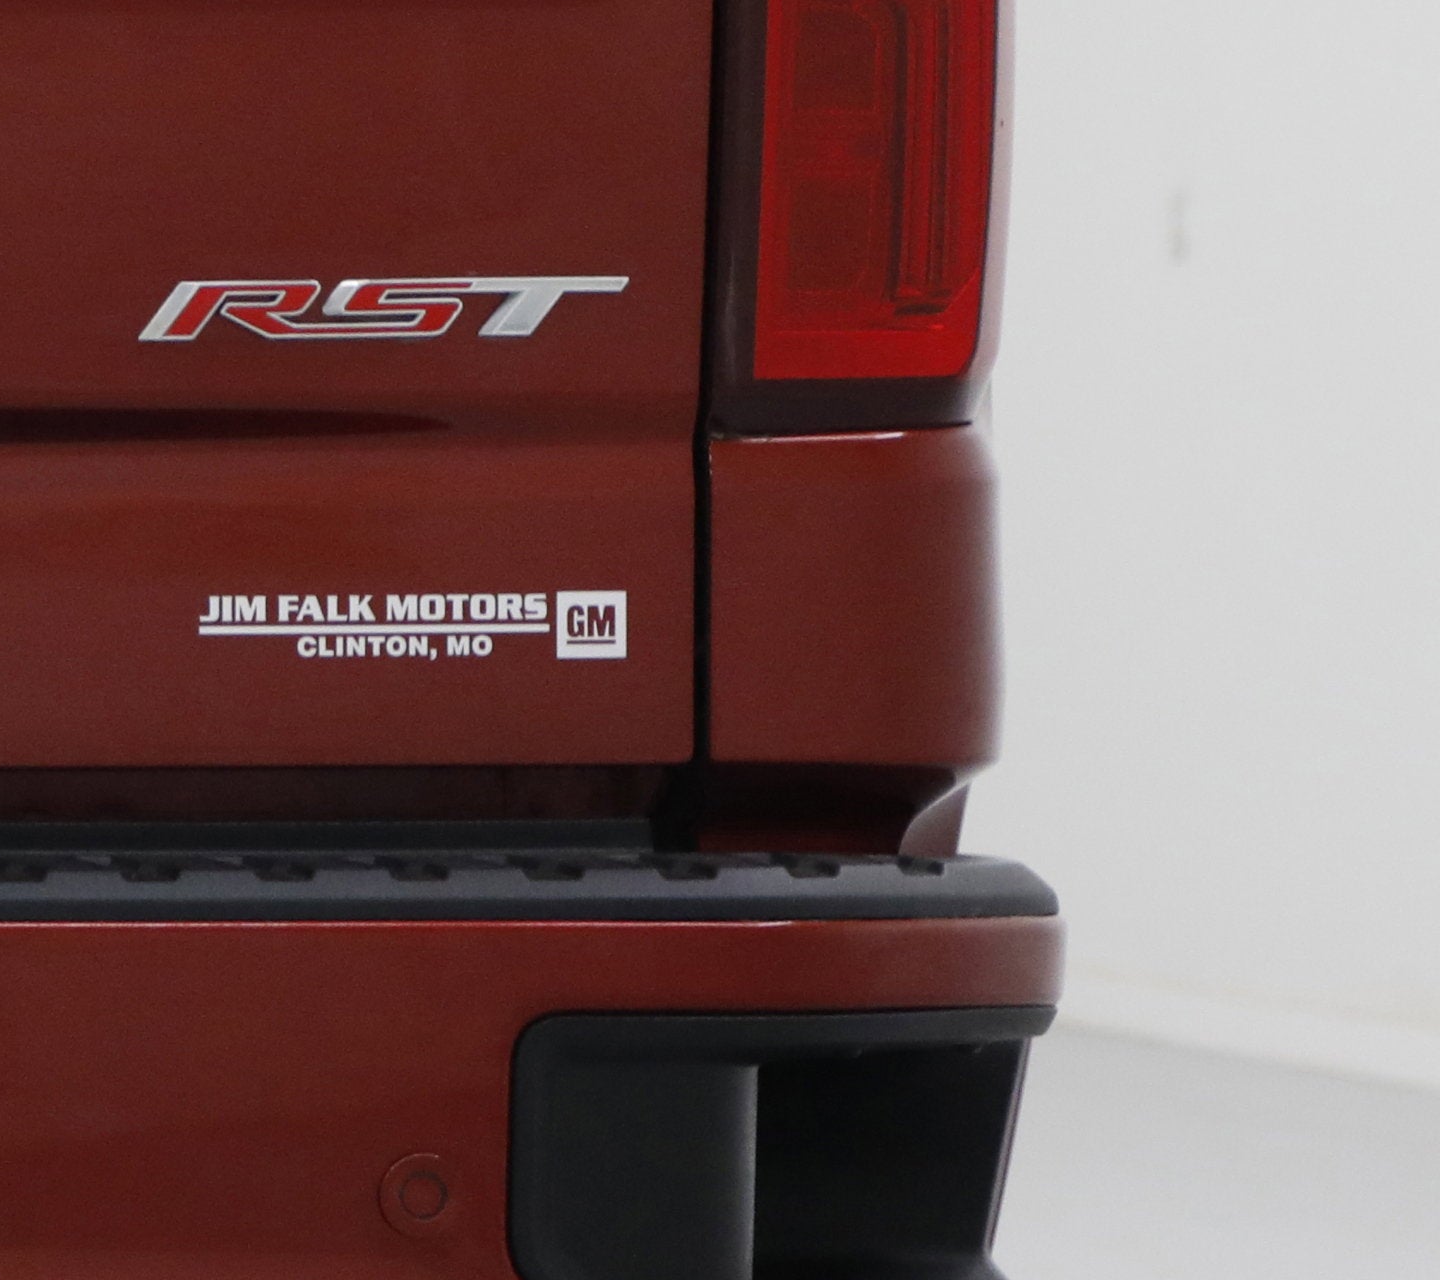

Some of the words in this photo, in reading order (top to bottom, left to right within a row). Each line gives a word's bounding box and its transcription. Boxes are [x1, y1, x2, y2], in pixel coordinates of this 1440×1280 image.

[137, 275, 630, 341] RST
[198, 594, 267, 623] JIM
[277, 593, 377, 623] FALK
[385, 592, 548, 622] MOTORS
[566, 604, 617, 639] GM
[296, 635, 438, 662] CLINTON,
[446, 635, 493, 657] MO
